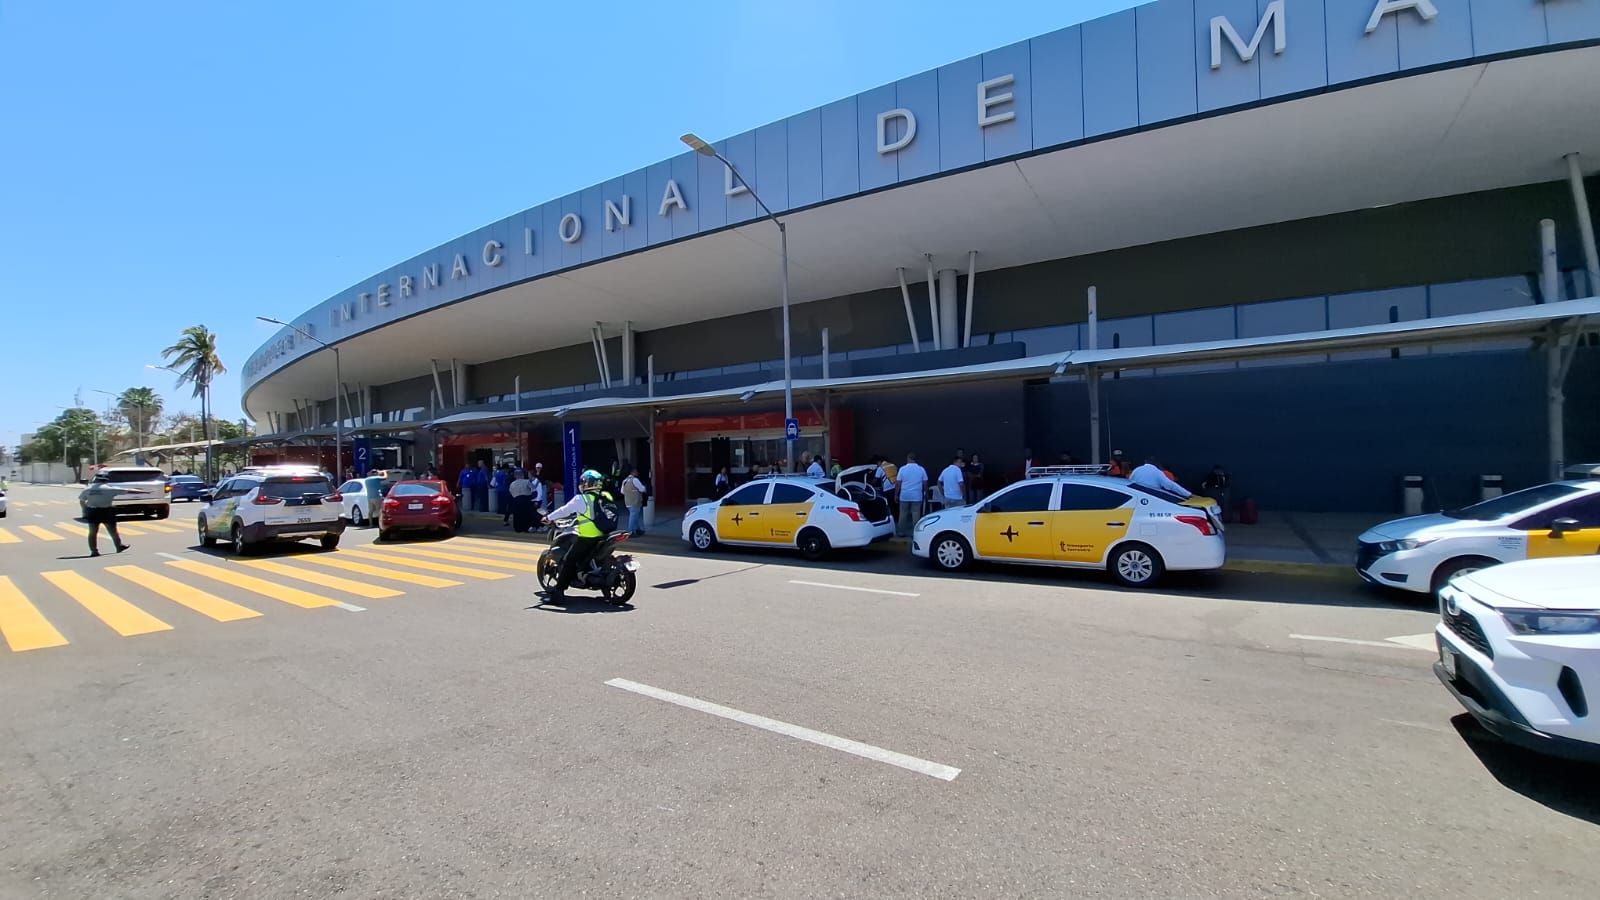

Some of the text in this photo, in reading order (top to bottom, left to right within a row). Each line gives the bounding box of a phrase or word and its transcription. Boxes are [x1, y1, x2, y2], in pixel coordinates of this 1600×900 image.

[328, 159, 752, 328] INTERNACIONAL
[875, 73, 1018, 155] DE
[568, 428, 575, 445] 1
[358, 447, 367, 460] 2
